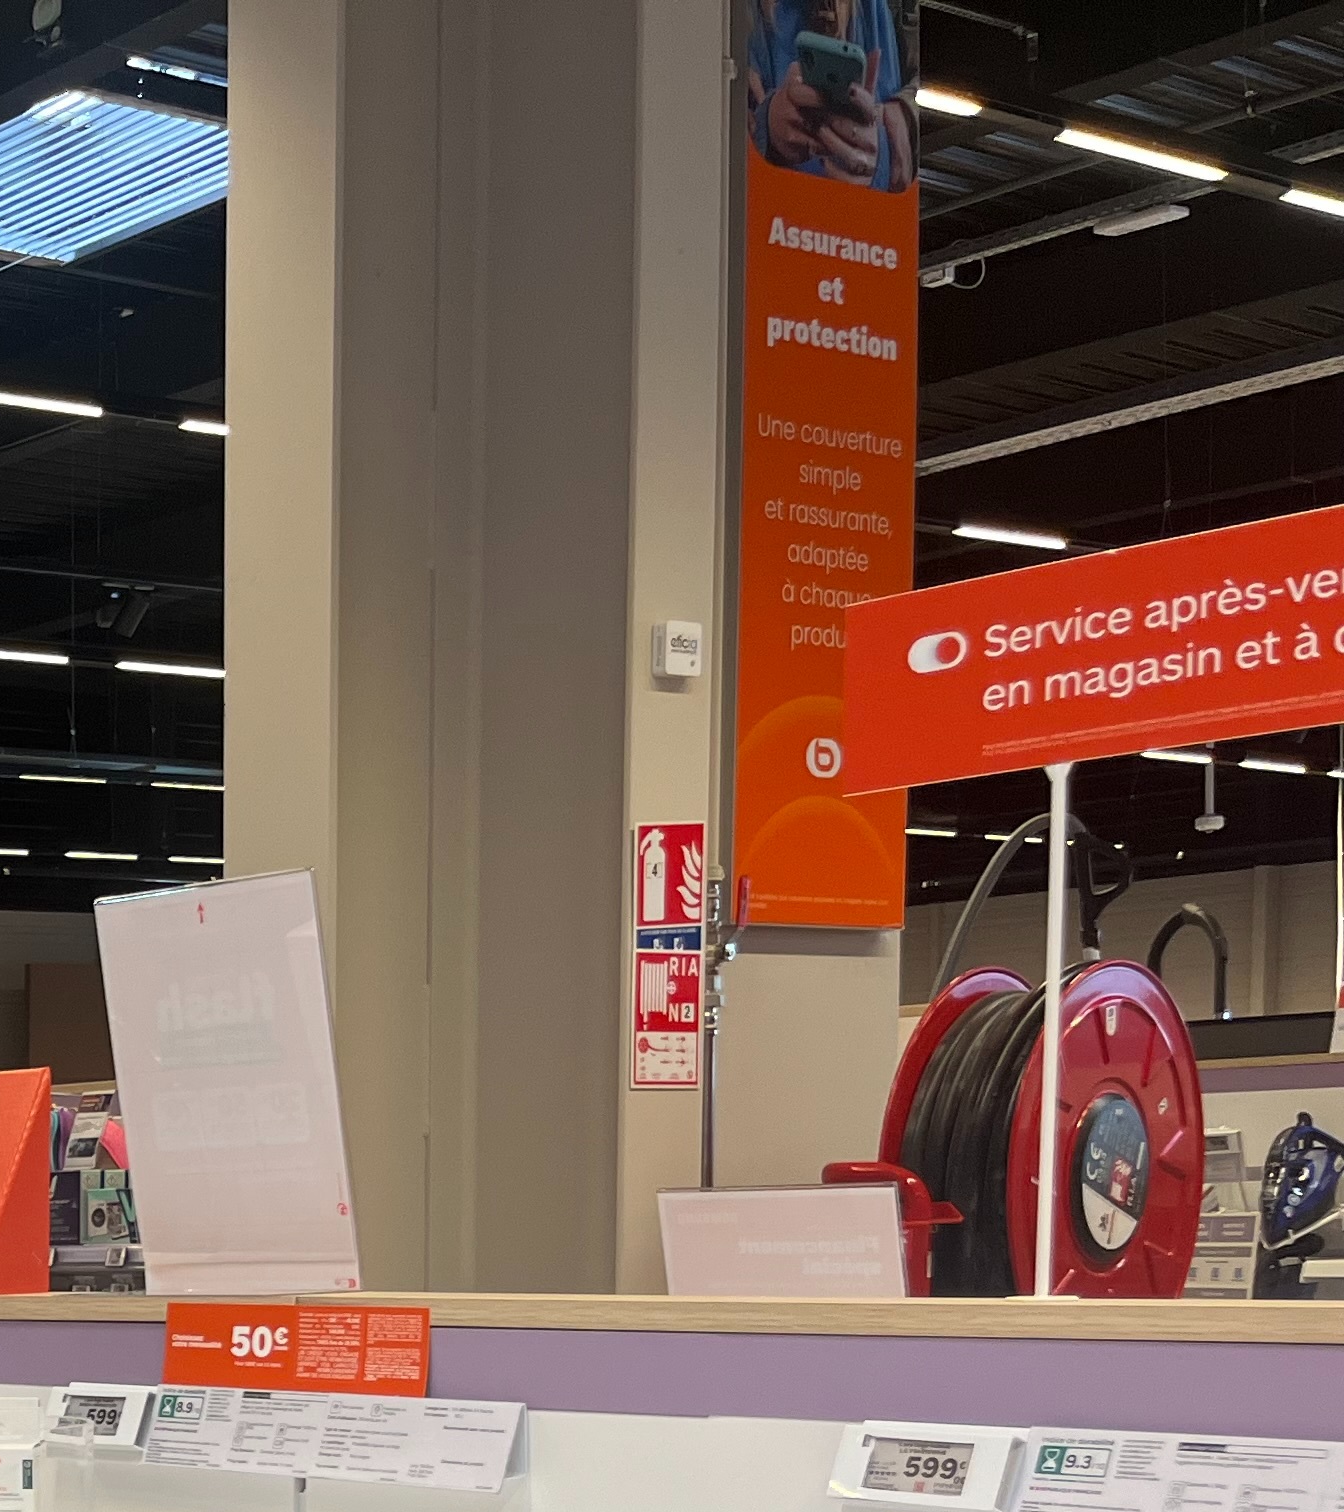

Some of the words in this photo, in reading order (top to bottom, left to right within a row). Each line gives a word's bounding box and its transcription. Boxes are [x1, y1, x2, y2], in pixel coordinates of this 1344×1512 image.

[768, 216, 898, 270] Assurance
[817, 276, 845, 305] et
[767, 316, 898, 361] protection
[758, 413, 795, 441] Une
[800, 422, 903, 458] couverture
[799, 459, 862, 495] simple
[764, 499, 783, 521] et
[789, 502, 894, 540] rassurante,
[787, 541, 869, 575] adaptée
[782, 578, 795, 602] à
[983, 606, 1134, 659] Service
[1144, 569, 1344, 632] après-ve
[790, 624, 846, 650] produ
[983, 679, 1030, 712] en
[1043, 642, 1222, 699] magasin
[1235, 630, 1282, 670] et
[1293, 623, 1322, 661] à
[668, 956, 699, 978] RIA
[230, 1325, 290, 1358] 50€
[1064, 1454, 1093, 1470] 9.3
